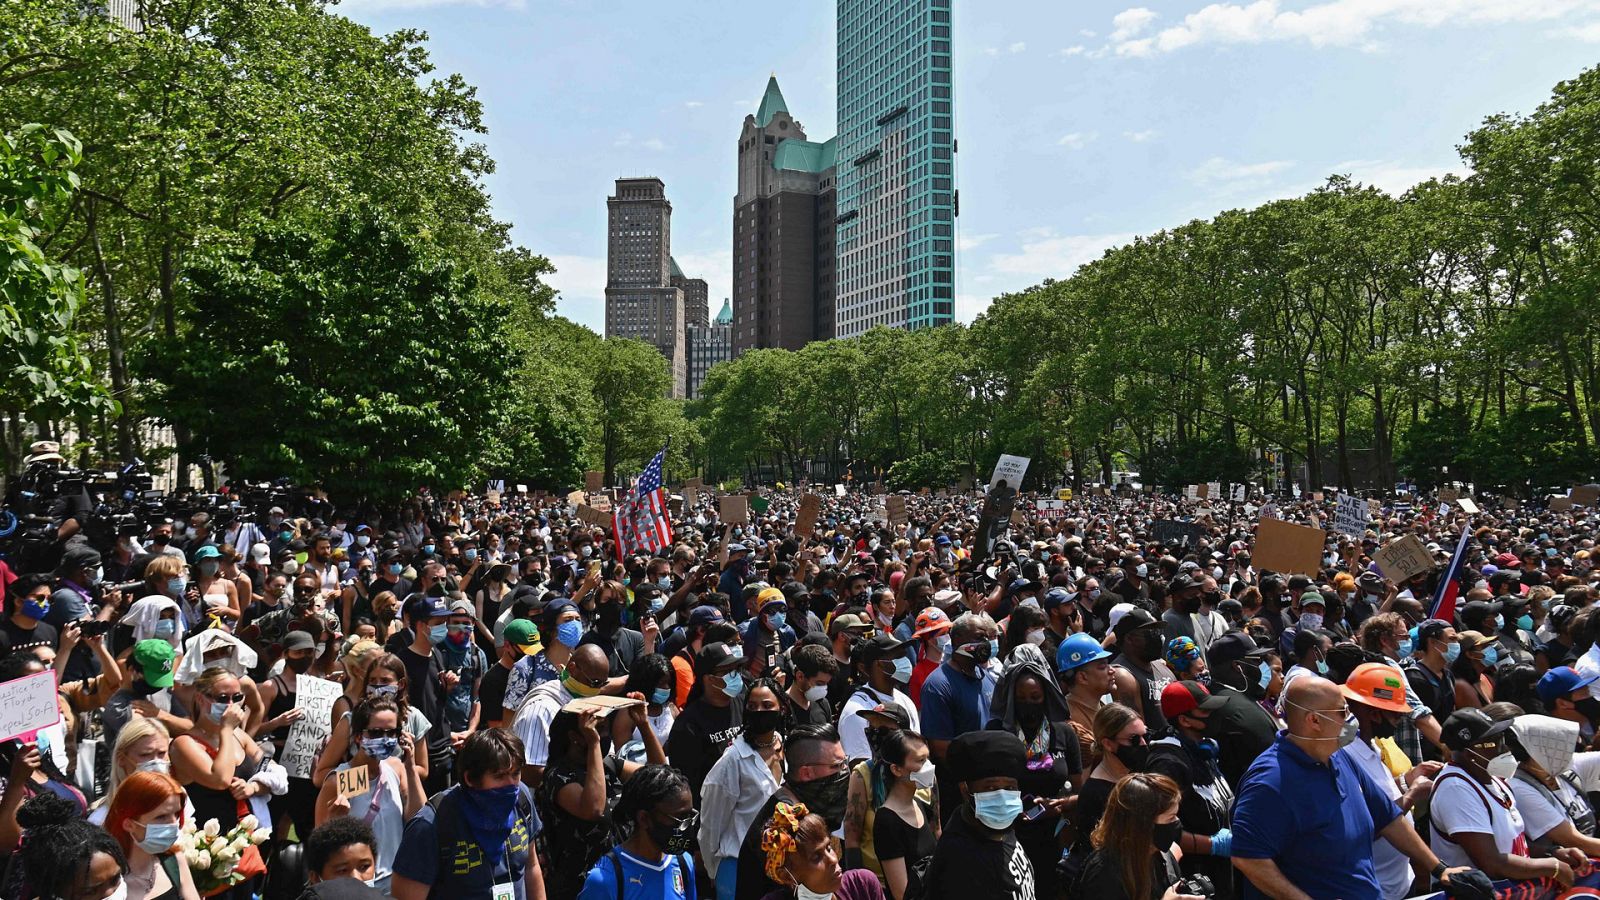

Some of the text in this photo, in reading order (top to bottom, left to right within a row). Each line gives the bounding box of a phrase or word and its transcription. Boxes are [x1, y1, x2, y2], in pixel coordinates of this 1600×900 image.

[1045, 500, 1054, 510] I
[1340, 495, 1360, 509] WE
[1336, 504, 1367, 522] SHALL
[1335, 514, 1366, 530] OVERCOME
[0, 685, 28, 700] ustice
[298, 695, 326, 710] FIRST
[299, 706, 331, 727] SNAC
[291, 722, 325, 740] HAND
[281, 752, 303, 765] JUST
[339, 767, 368, 794] BLM
[1008, 840, 1029, 886] STOP
